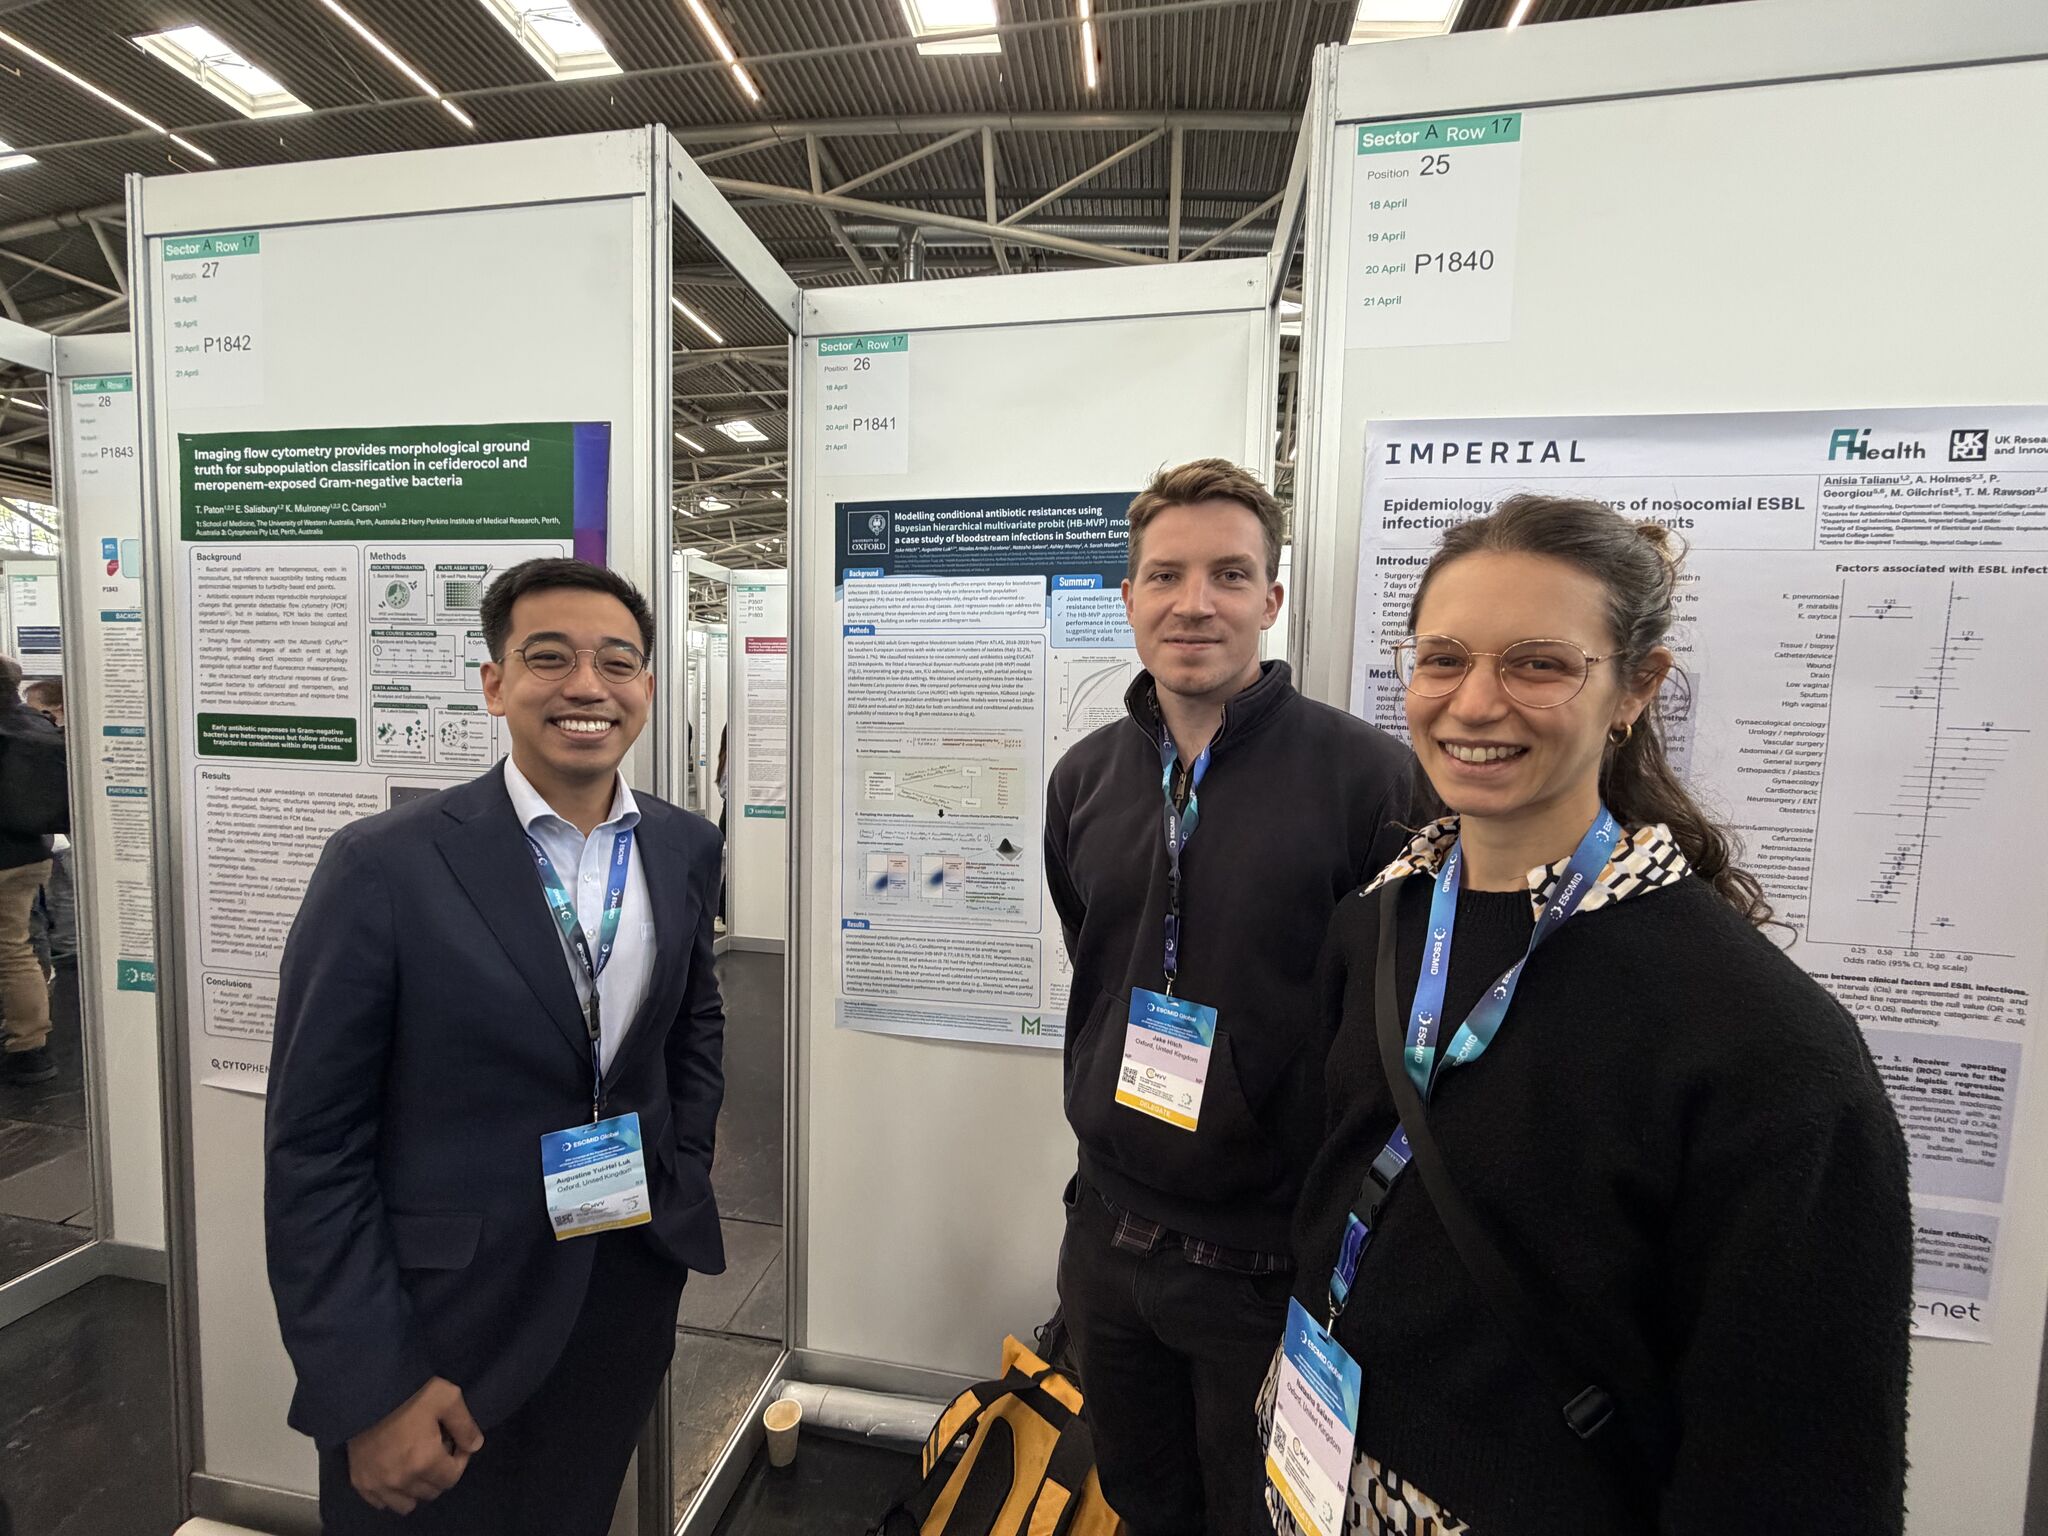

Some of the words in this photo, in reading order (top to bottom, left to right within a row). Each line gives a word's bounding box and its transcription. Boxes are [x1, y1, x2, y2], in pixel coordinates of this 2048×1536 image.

[1363, 131, 1420, 147] Sector
[1425, 124, 1438, 140] A
[1446, 127, 1486, 142] Row
[1492, 118, 1512, 134] 17
[1368, 169, 1409, 180] Position
[1420, 154, 1450, 176] 25
[1370, 201, 1381, 209] 18
[1383, 199, 1407, 209] April
[1368, 233, 1379, 242] 19
[1381, 231, 1406, 242] April
[166, 245, 200, 256] Sector
[204, 240, 212, 250] A
[216, 242, 239, 252] Row
[243, 236, 254, 247] 17
[1366, 265, 1379, 274] 20
[1382, 264, 1406, 274] April
[1415, 250, 1493, 274] P1840
[202, 262, 219, 278] 27
[1364, 298, 1375, 306] 21
[1377, 296, 1401, 306] April
[204, 335, 251, 353] P1842
[821, 342, 853, 352] Sector
[856, 339, 863, 348] A
[868, 341, 889, 350] Row
[892, 337, 903, 346] 17
[854, 358, 870, 370] 26
[99, 396, 111, 407] 28
[853, 417, 896, 431] P1841
[1995, 436, 2010, 444] UK
[101, 447, 133, 458] P1843
[194, 448, 241, 461] Imaging
[244, 448, 269, 459] flow
[271, 446, 331, 459] cytometry
[335, 444, 386, 457] provides
[389, 441, 479, 456] morphological
[483, 440, 530, 454] ground
[1386, 440, 1585, 464] IMPERIAL
[195, 464, 223, 475] truth
[226, 464, 241, 474] for
[245, 461, 328, 476] subpopulation
[331, 459, 410, 472] classification
[414, 459, 425, 470] in
[429, 457, 499, 470] cefiderocol
[503, 456, 527, 468] and
[195, 478, 316, 491] meropenem-exposed
[319, 475, 408, 490] Gram-negative
[412, 474, 463, 486] bacteria
[1824, 477, 1858, 485] Anisia
[1891, 489, 1904, 497] M.
[1384, 498, 1492, 514] Epidemiology
[1630, 498, 1648, 510] of
[1652, 497, 1752, 511] nosocomial
[1757, 498, 1805, 510] ESBL
[895, 511, 935, 522] Modelling
[937, 509, 983, 519] conditional
[986, 507, 1026, 518] antibiotic
[1028, 507, 1076, 516] resistances
[1078, 506, 1102, 516] using
[895, 524, 931, 534] Bayesian
[933, 522, 982, 531] hierarchical
[984, 520, 1036, 530] multivariate
[1038, 519, 1064, 530] probit
[1067, 518, 1108, 529] (HB-MVP)
[922, 535, 944, 544] study
[946, 534, 955, 542] of
[956, 533, 1009, 543] bloodstream
[1012, 532, 1053, 541] infections
[1055, 531, 1063, 540] in
[1066, 531, 1106, 539] Southern
[1108, 530, 1129, 538] Euro
[197, 553, 241, 561] Background
[370, 552, 406, 560] Methods
[1376, 556, 1431, 566] Introduc
[849, 570, 878, 578] Background
[1883, 565, 1945, 573] associated
[1949, 565, 1974, 573] with
[2012, 565, 2048, 574] infect
[1059, 577, 1095, 588] Summary
[1390, 582, 1406, 590] days
[1369, 670, 1399, 679] Meth
[202, 772, 230, 780] Results
[1772, 778, 1819, 786] Gynaecology
[1765, 787, 1817, 795] Cardiothoracic
[1558, 873, 1583, 907] ESCMID
[847, 920, 865, 928] Results
[1431, 941, 1442, 975] ESCMID
[207, 977, 252, 988] Conclusions
[1153, 1035, 1166, 1044] Jake
[1167, 1039, 1182, 1049] Hitch
[1414, 1026, 1428, 1064] ESCMID
[1135, 1038, 1154, 1051] Oxford,
[1156, 1044, 1173, 1055] United
[1174, 1049, 1198, 1063] Kingdom
[223, 1061, 270, 1073] CYTOPHEN
[557, 1171, 591, 1184] Augustine
[618, 1159, 630, 1167] Luk
[583, 1175, 603, 1187] United
[604, 1167, 632, 1179] Kingdom
